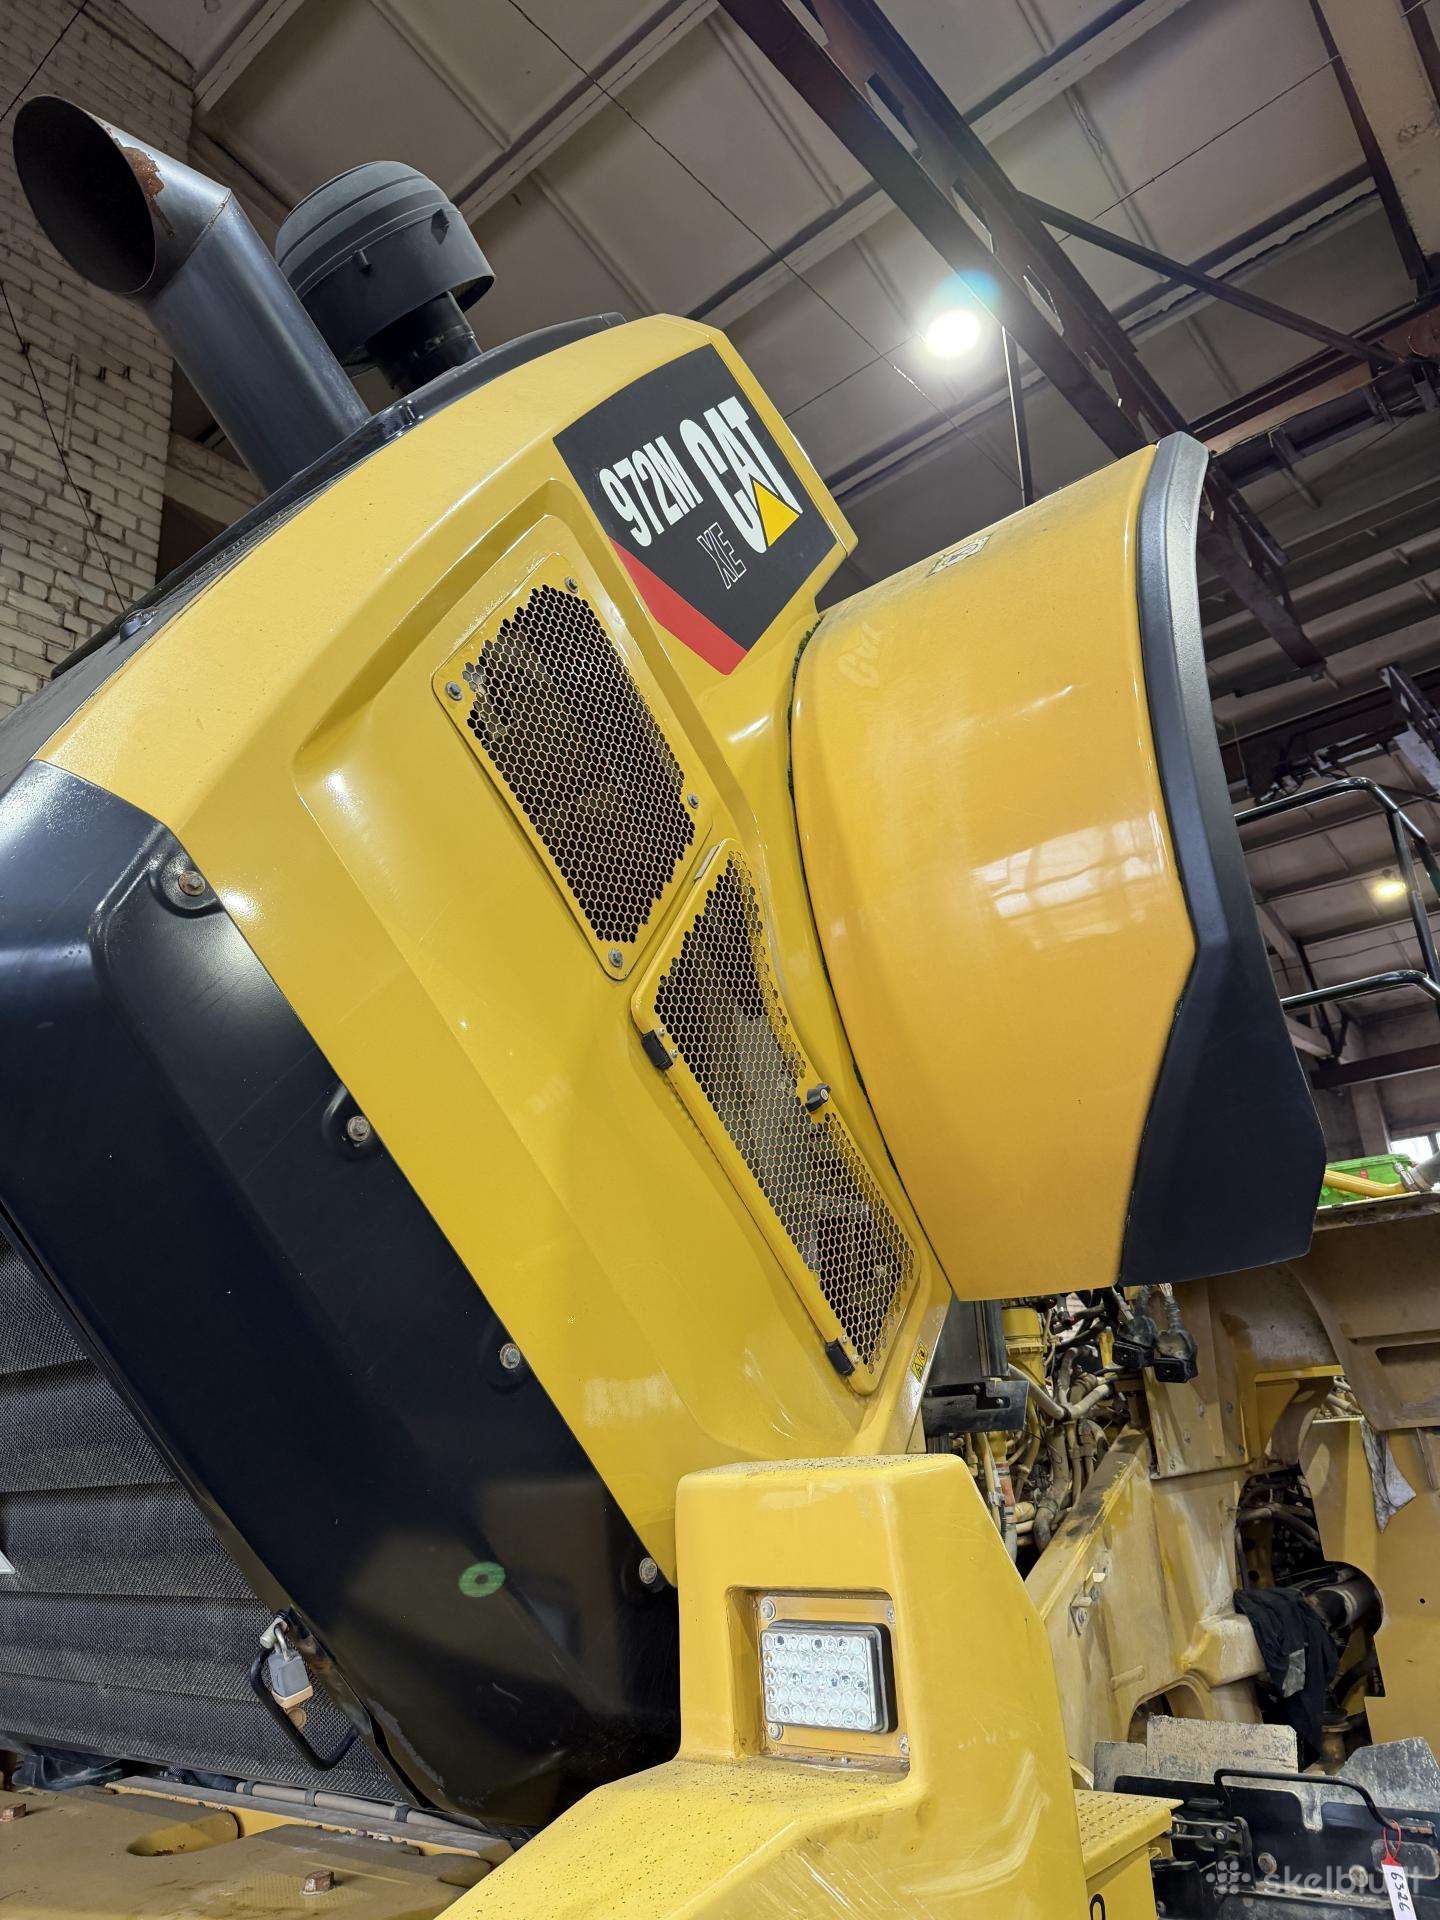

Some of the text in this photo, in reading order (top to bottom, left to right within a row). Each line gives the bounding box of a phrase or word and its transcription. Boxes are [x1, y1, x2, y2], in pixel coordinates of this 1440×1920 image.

[599, 396, 803, 553] 972M CAT
[696, 522, 747, 589] XE
